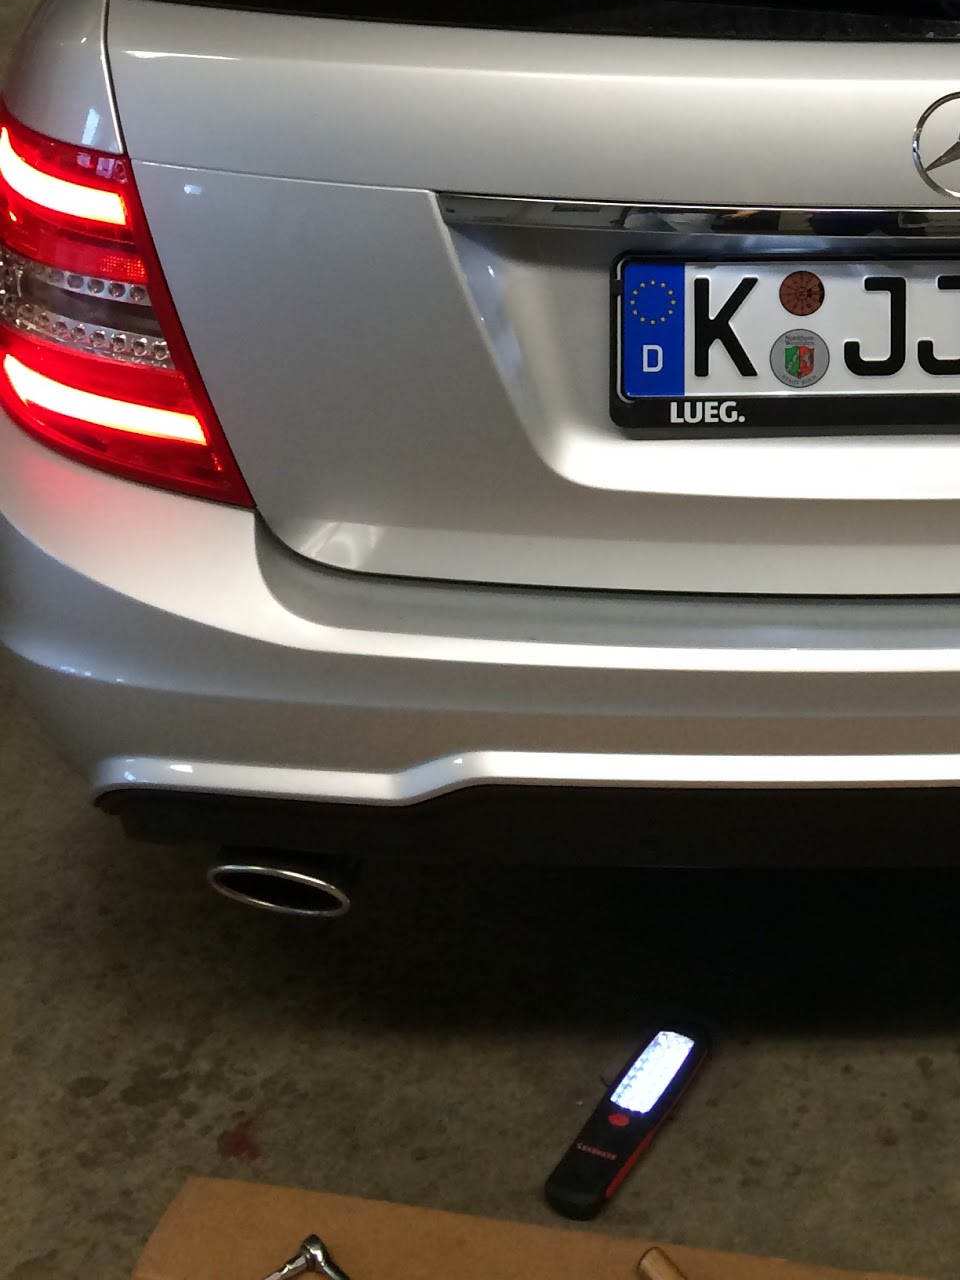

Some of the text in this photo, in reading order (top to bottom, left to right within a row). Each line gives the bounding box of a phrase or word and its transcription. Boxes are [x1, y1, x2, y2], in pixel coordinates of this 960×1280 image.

[693, 277, 759, 378] K
[643, 344, 663, 372] D
[670, 401, 746, 424] LUEG.
